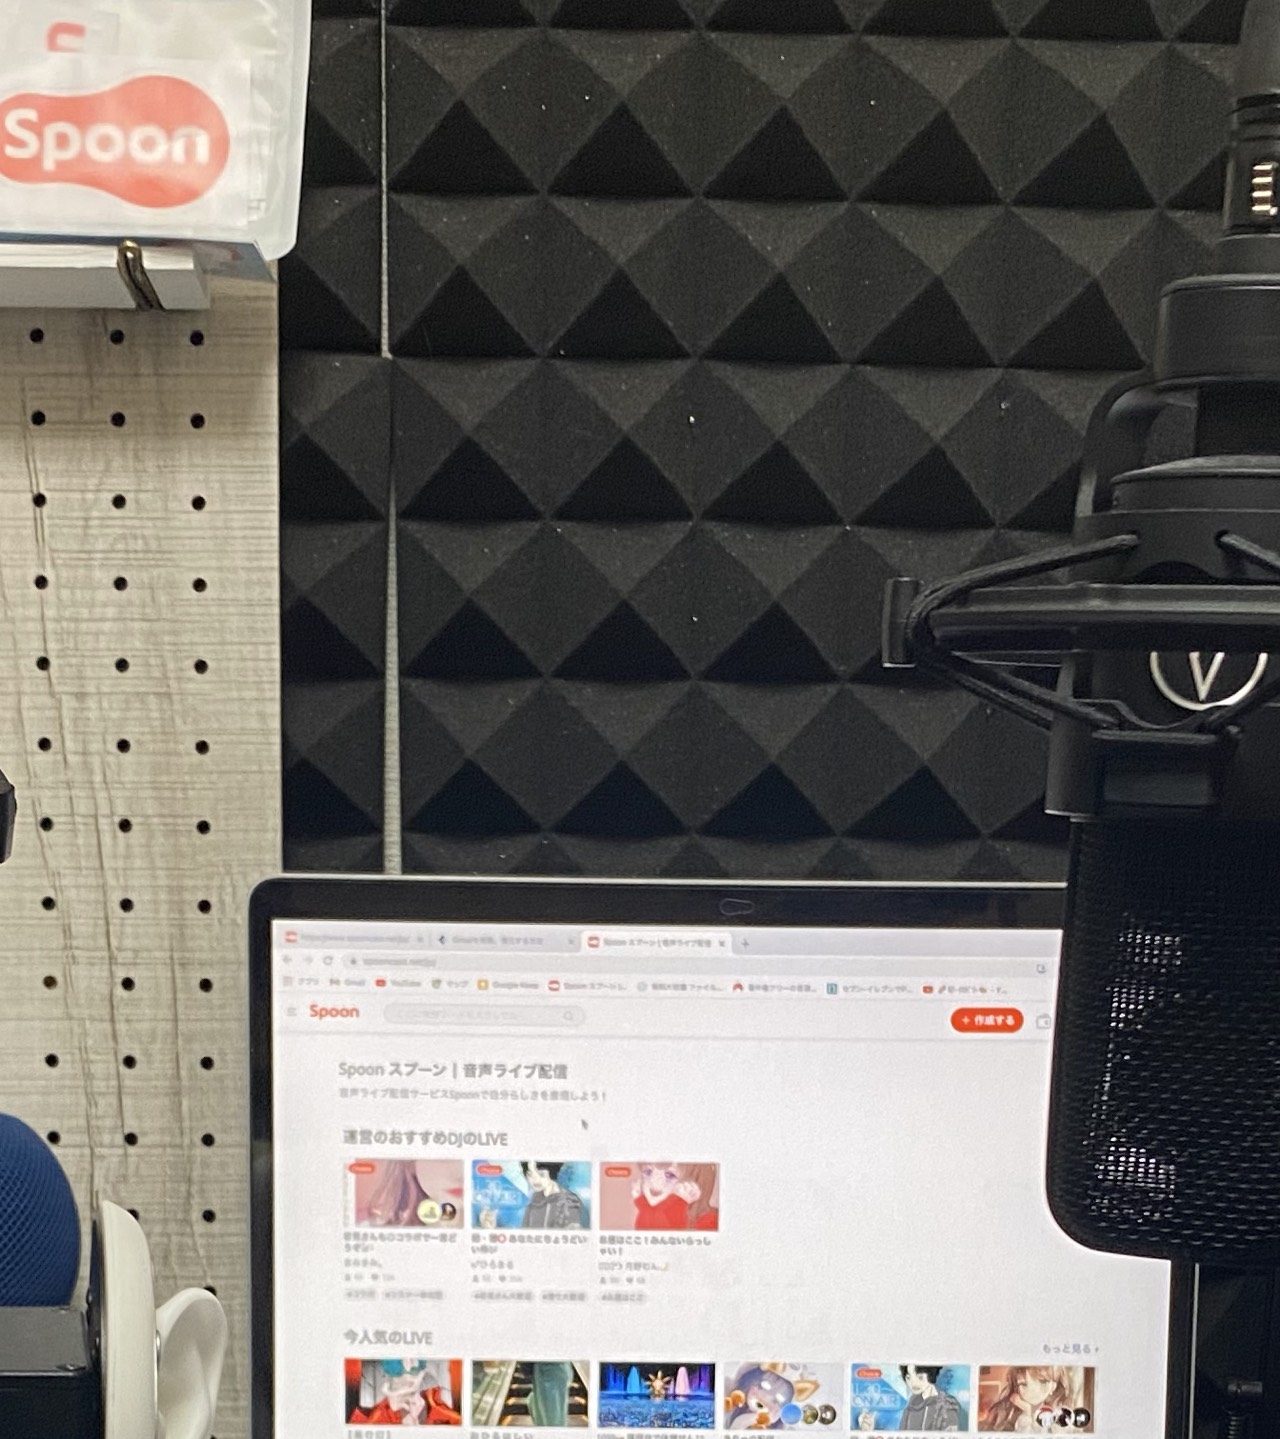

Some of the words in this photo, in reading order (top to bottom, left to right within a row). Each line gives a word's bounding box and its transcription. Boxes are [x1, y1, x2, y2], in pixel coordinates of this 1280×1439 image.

[4, 108, 210, 170] Spoon
[309, 1004, 360, 1020] Spoon
[338, 1063, 385, 1077] Spoon
[389, 1062, 447, 1077] スプーン
[463, 1063, 568, 1079] 音声ライブ配信
[343, 1129, 508, 1147] 運営のおすすめDJのLIVE
[344, 1329, 433, 1345] 今人気のLIVE
